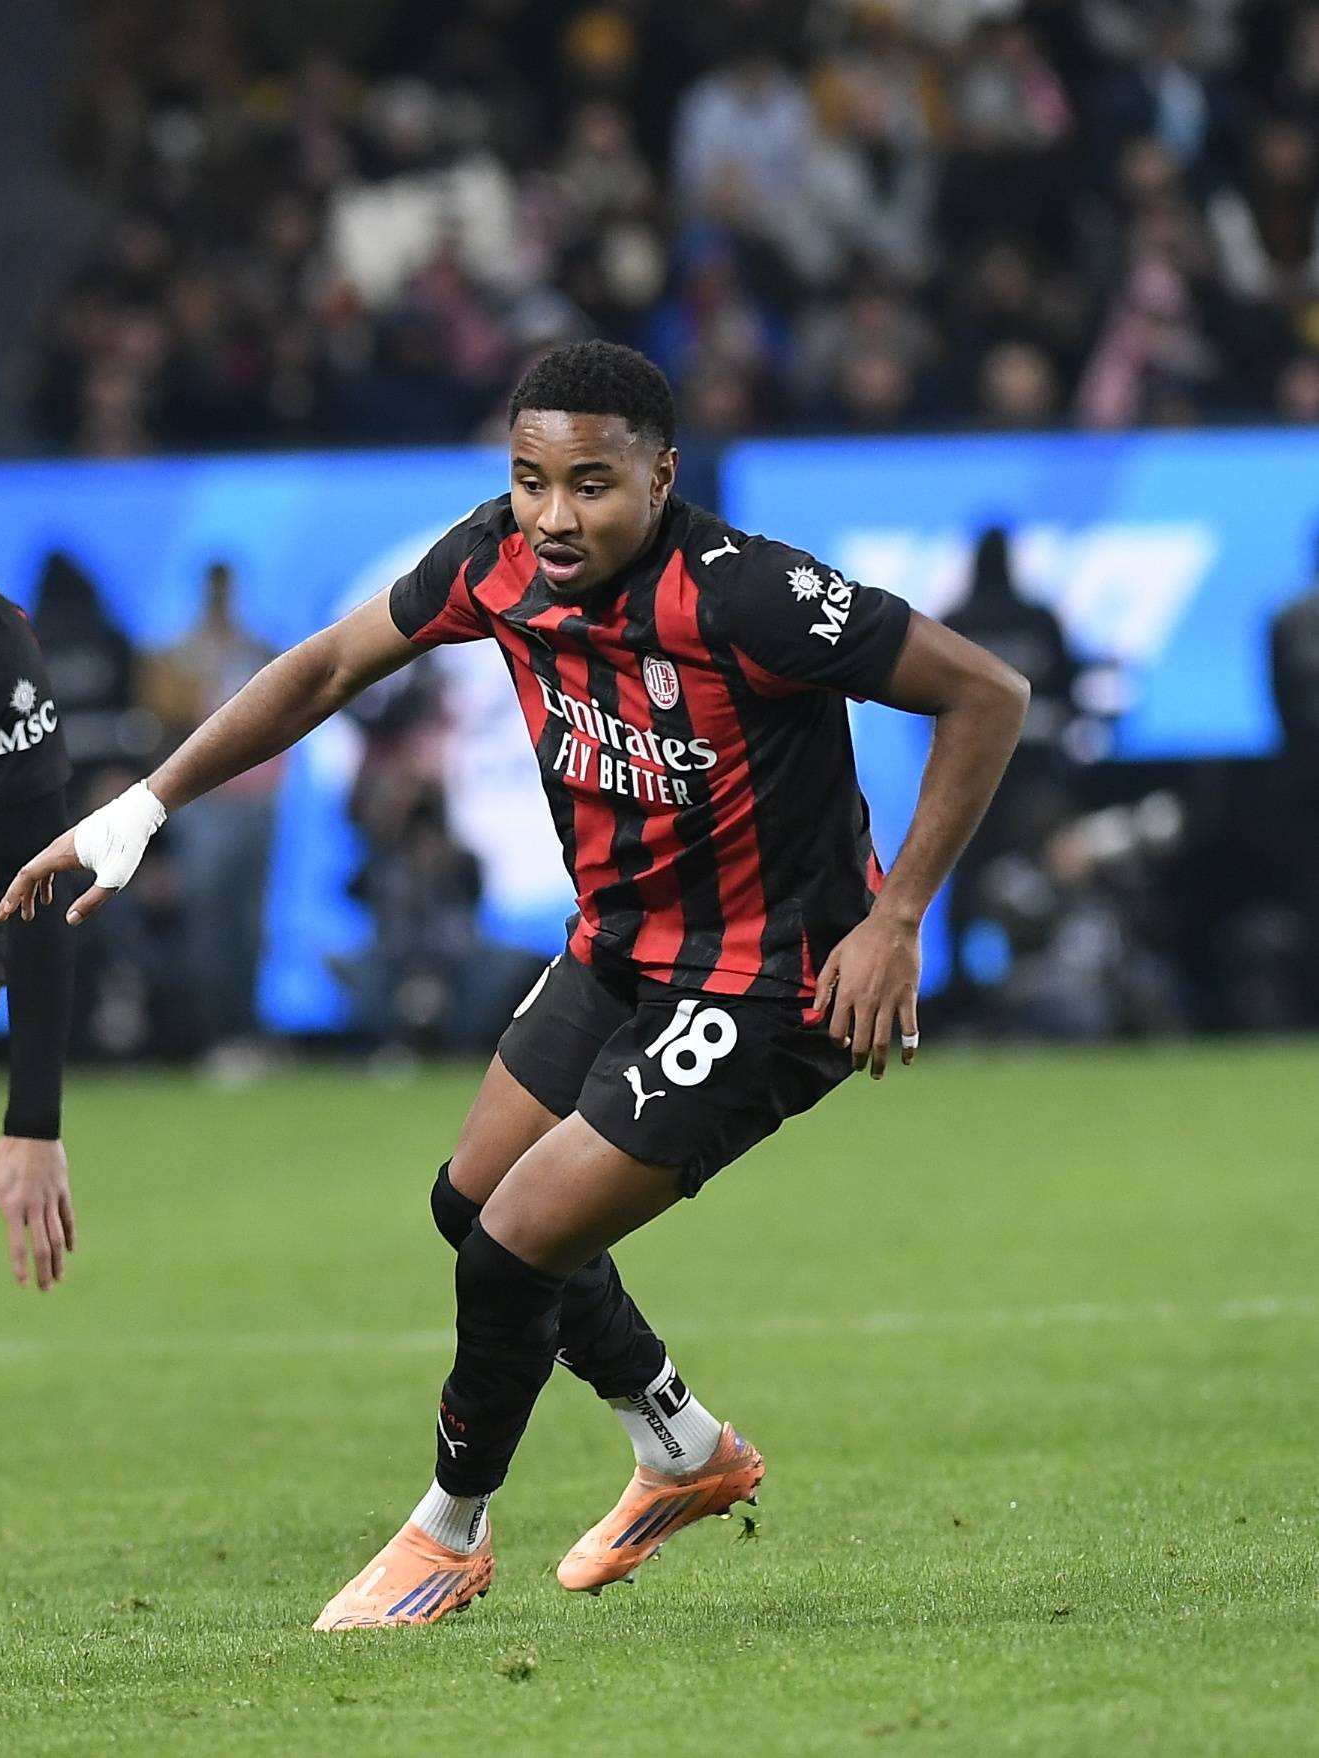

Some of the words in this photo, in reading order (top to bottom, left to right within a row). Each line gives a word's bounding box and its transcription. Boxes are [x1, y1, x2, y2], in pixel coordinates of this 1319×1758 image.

[535, 672, 718, 772] Emirates
[553, 731, 592, 782] FLY
[599, 753, 694, 806] BETTER
[644, 999, 738, 1087] 18
